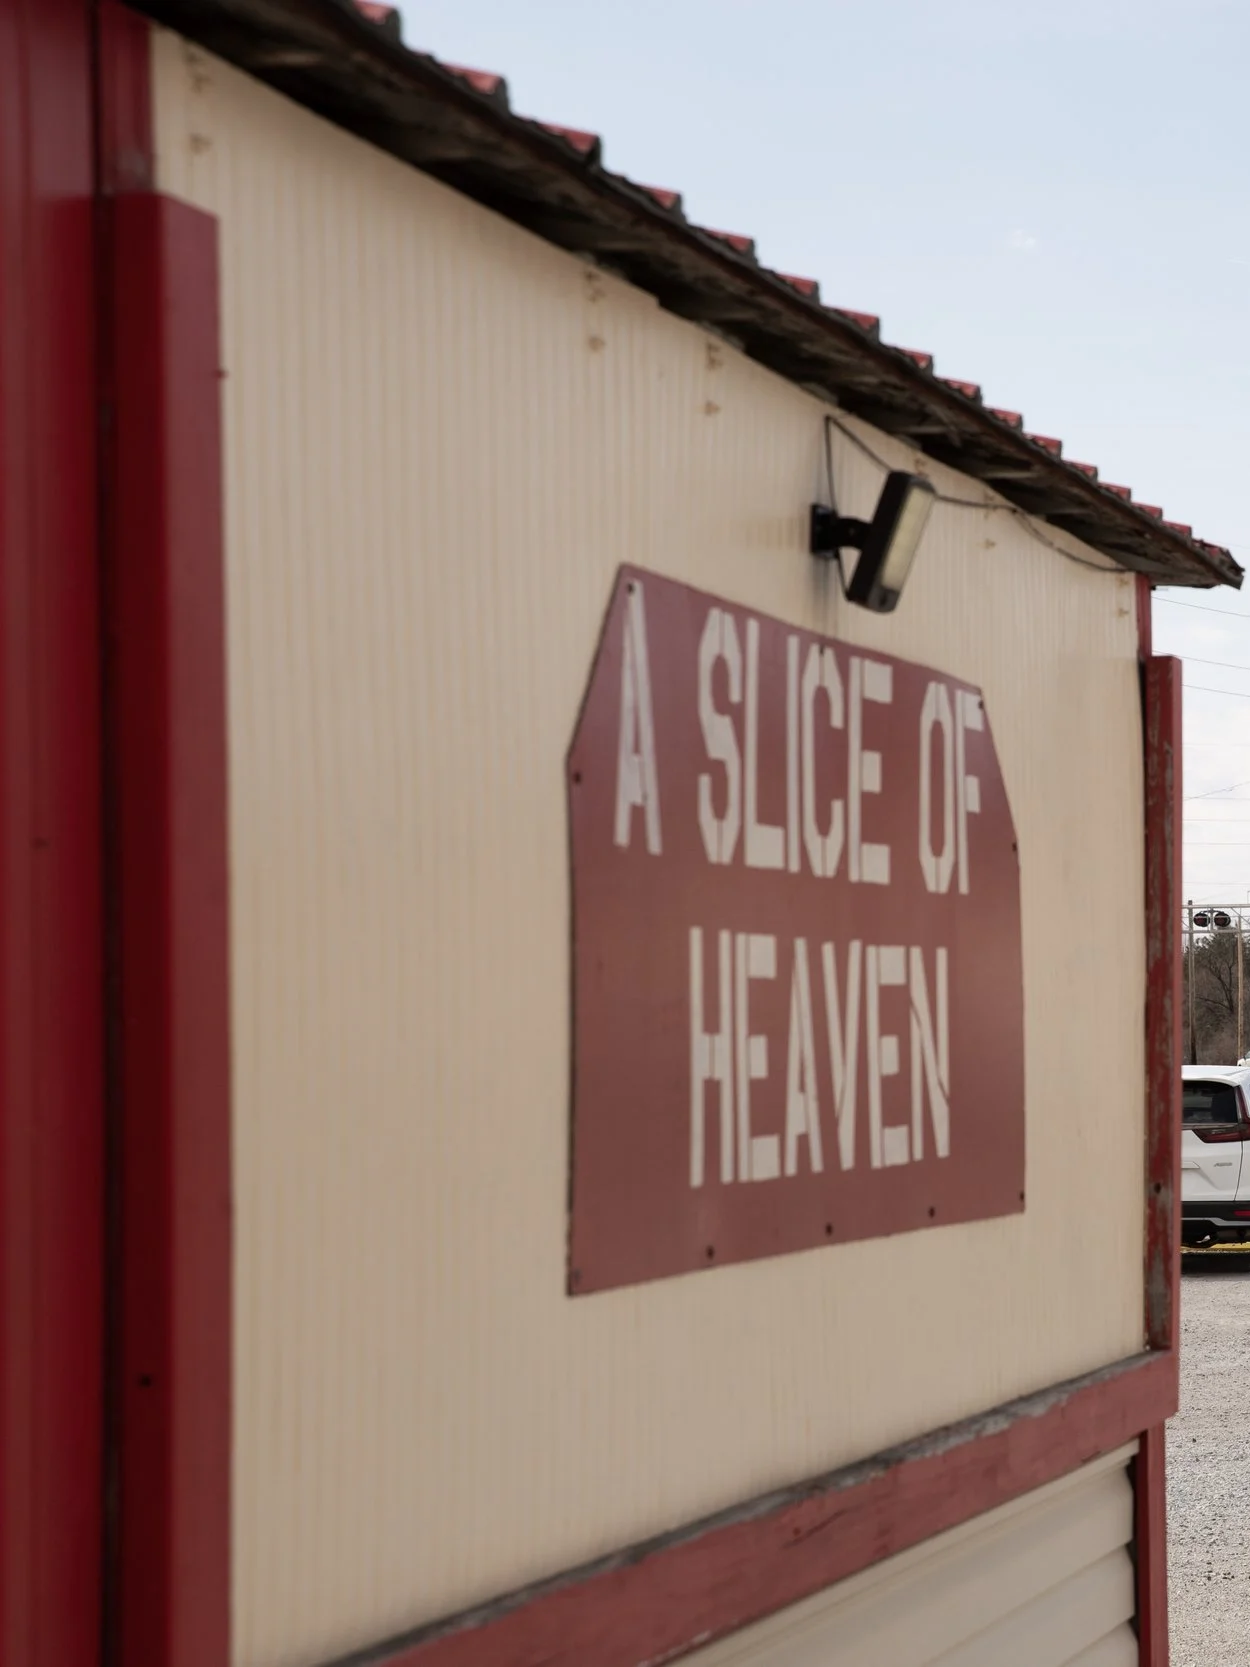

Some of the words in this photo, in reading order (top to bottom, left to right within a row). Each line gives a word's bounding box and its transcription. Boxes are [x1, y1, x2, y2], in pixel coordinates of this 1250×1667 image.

[614, 578, 662, 855] A
[698, 607, 893, 885] SLICE
[919, 680, 985, 895] OF
[689, 926, 951, 1188] HEAVEN
